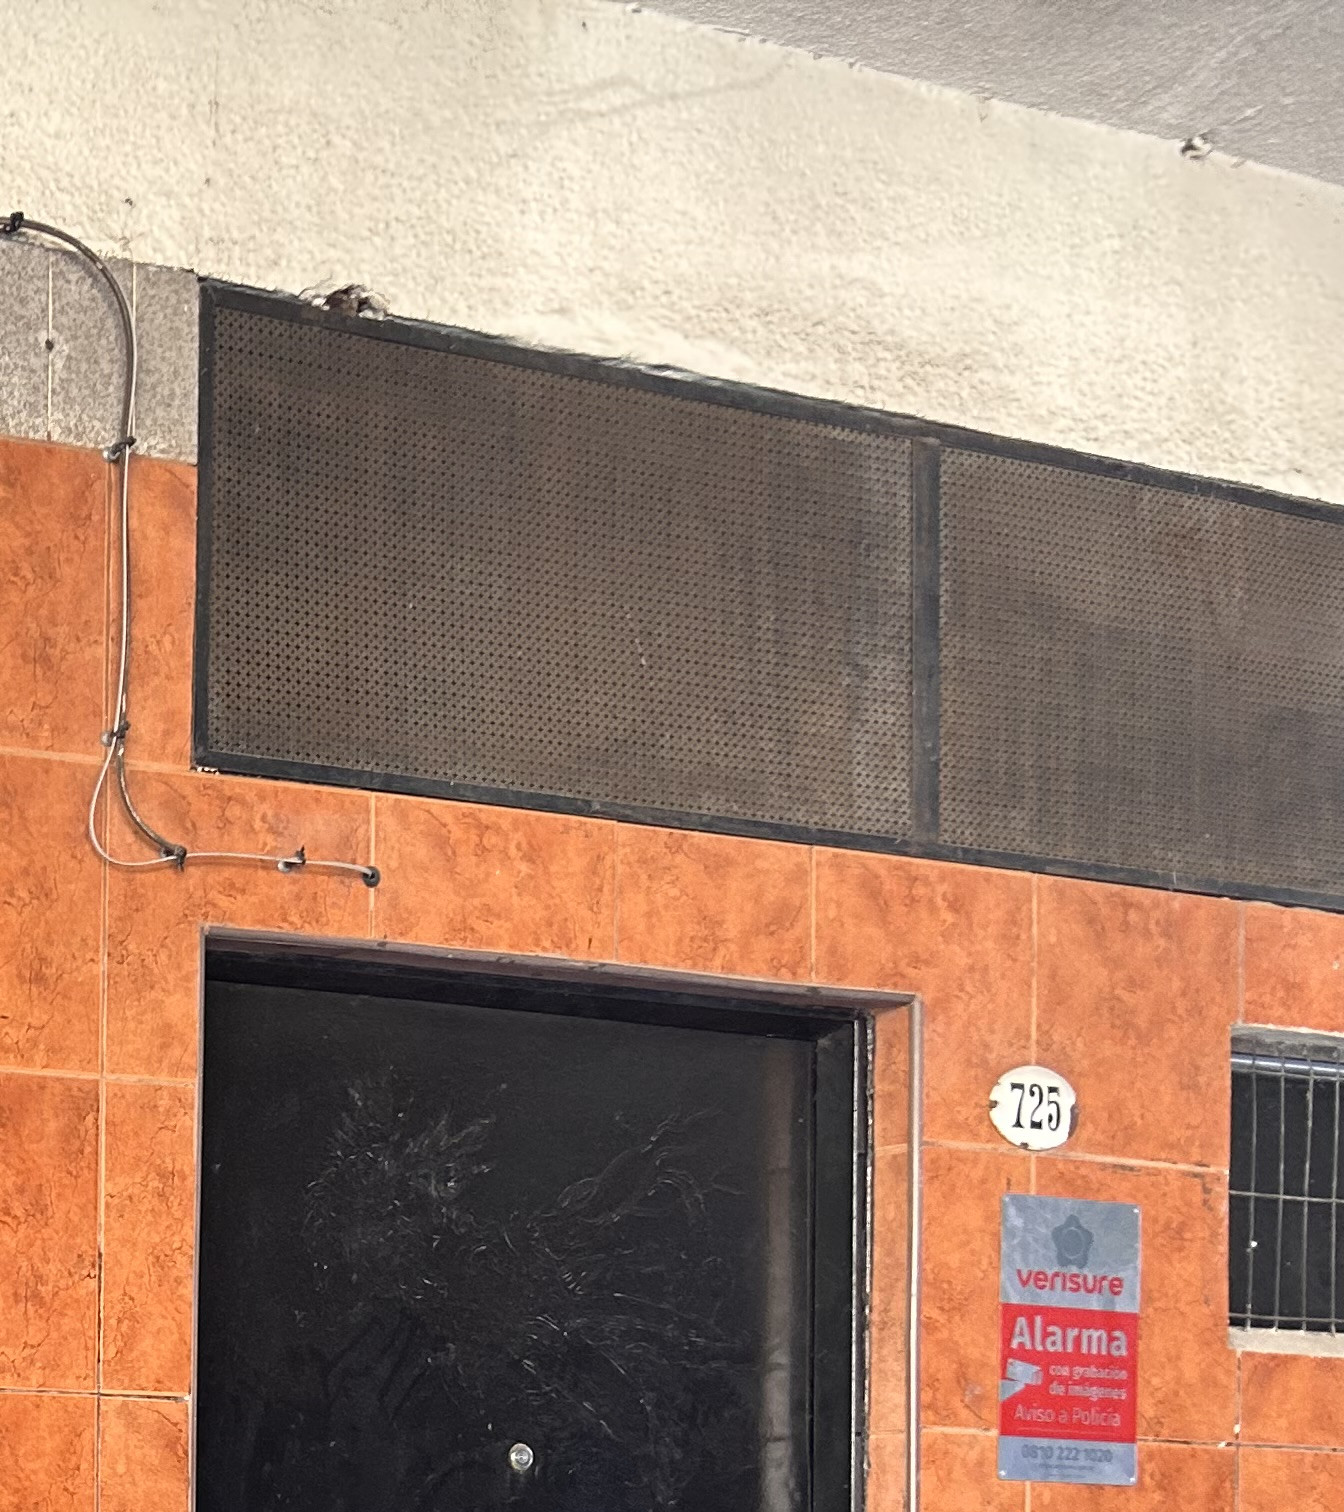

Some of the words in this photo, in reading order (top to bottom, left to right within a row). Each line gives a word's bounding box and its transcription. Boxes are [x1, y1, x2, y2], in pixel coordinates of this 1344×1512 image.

[1010, 1082, 1060, 1131] 725
[1016, 1269, 1124, 1296] verisure
[1011, 1315, 1127, 1357] Alarma
[1049, 1365, 1070, 1376] con
[1049, 1381, 1066, 1396] de
[1014, 1403, 1056, 1422] Aviso
[1058, 1409, 1069, 1423] a
[1072, 1407, 1121, 1426] Policía
[1056, 1446, 1079, 1461] 222
